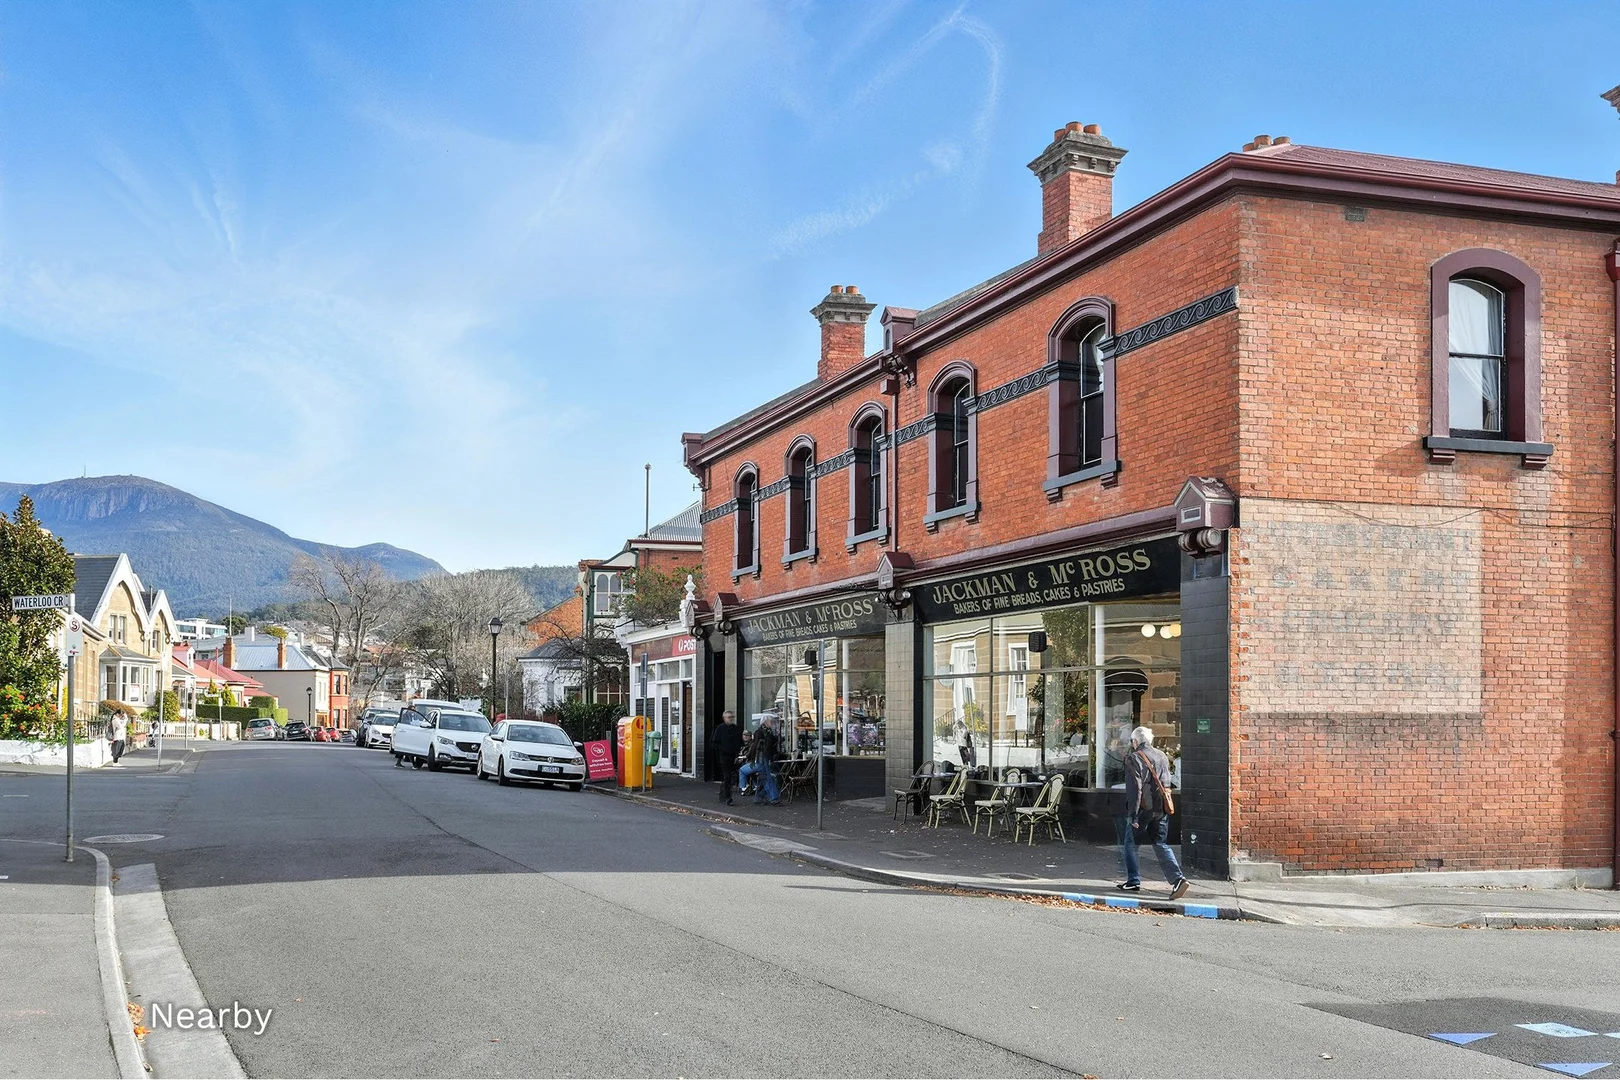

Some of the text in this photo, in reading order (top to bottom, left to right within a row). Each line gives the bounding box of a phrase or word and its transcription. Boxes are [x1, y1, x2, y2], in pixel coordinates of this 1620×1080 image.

[933, 573, 1017, 604] JACKMAN
[1027, 571, 1039, 589] &
[953, 578, 1125, 615] BAKERS OF FINE BREADS, CAKES & PASTRIES
[14, 595, 64, 608] WATERLOO CR
[747, 610, 801, 634] JACKMAN
[805, 610, 812, 624] &
[762, 631, 779, 642] BAKERS
[778, 630, 785, 639] OF
[784, 628, 796, 638] FINE
[813, 623, 829, 634] CAKES
[833, 619, 858, 631] PASTRIES
